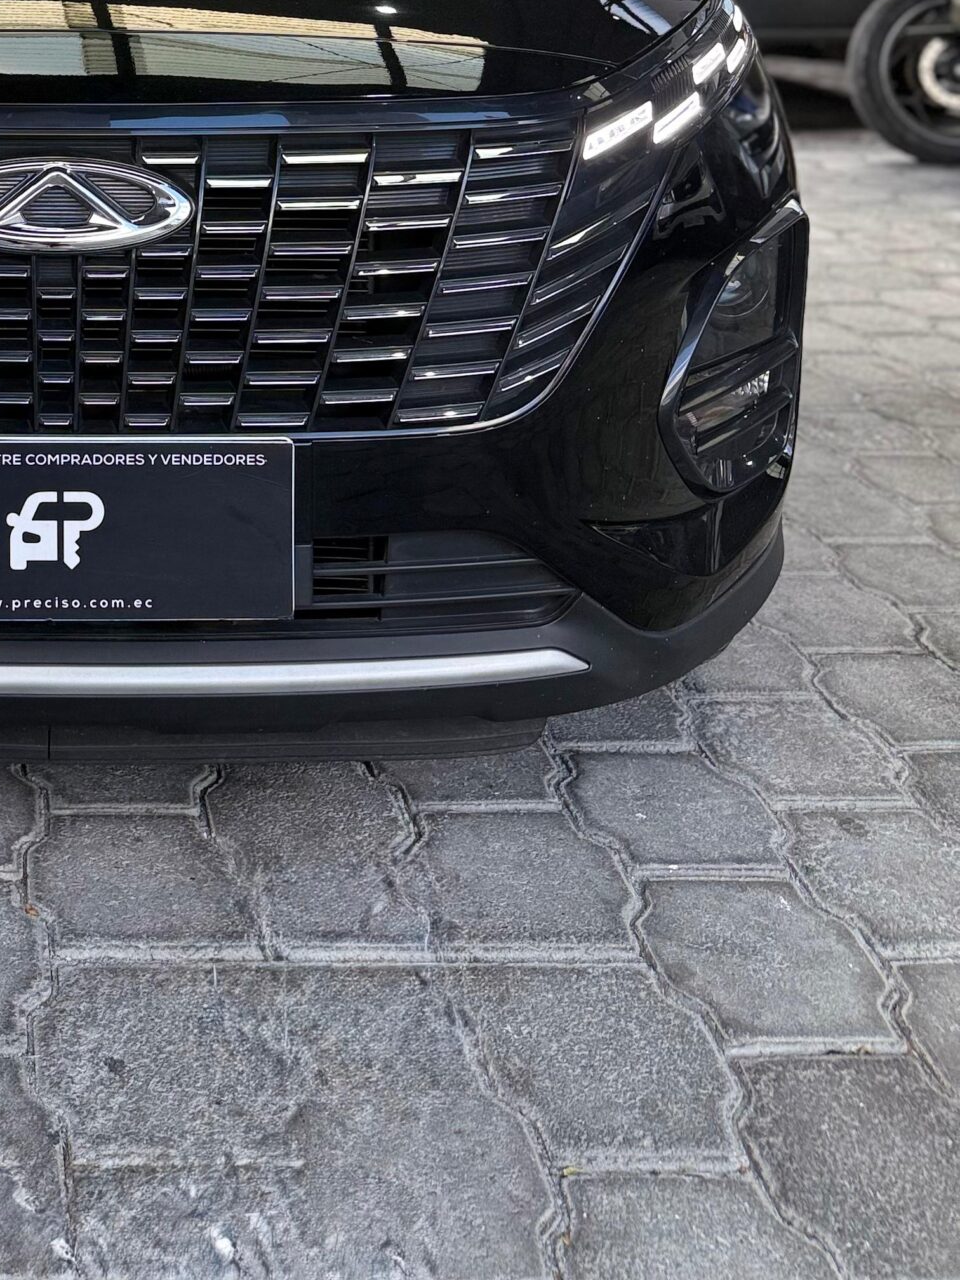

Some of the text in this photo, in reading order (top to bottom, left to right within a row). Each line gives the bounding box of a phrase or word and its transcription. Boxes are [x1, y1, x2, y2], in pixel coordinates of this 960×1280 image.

[25, 453, 145, 466] COMPRADORES
[148, 454, 157, 465] Y
[160, 454, 266, 466] VENDEDORES
